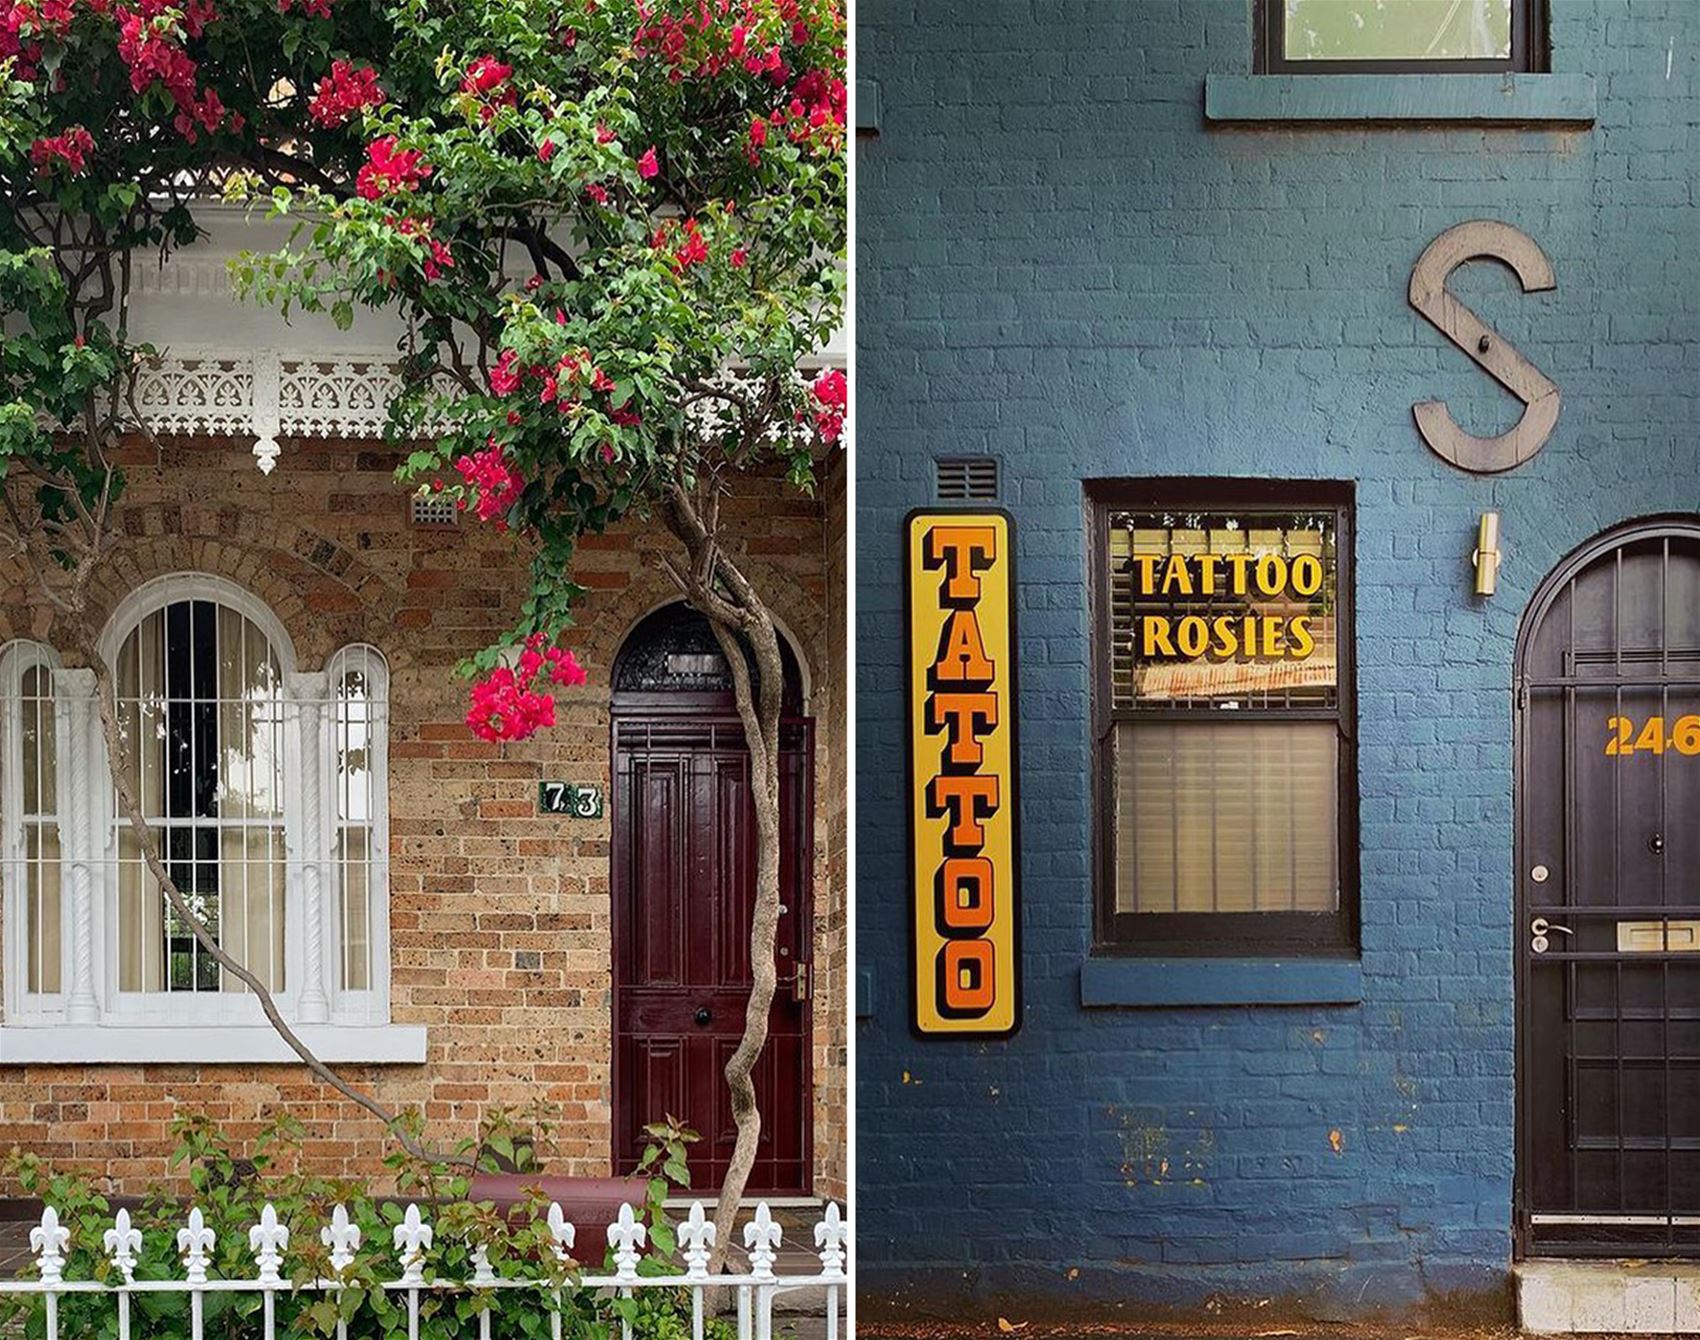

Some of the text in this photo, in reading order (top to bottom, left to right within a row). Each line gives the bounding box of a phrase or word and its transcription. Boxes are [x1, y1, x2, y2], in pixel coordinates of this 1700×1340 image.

[1408, 219, 1561, 474] S
[1132, 553, 1324, 596] TATTOO
[1142, 615, 1316, 658] ROSIES
[1604, 715, 1700, 756] 246
[923, 526, 999, 1020] TATTOO
[545, 782, 597, 817] 73
